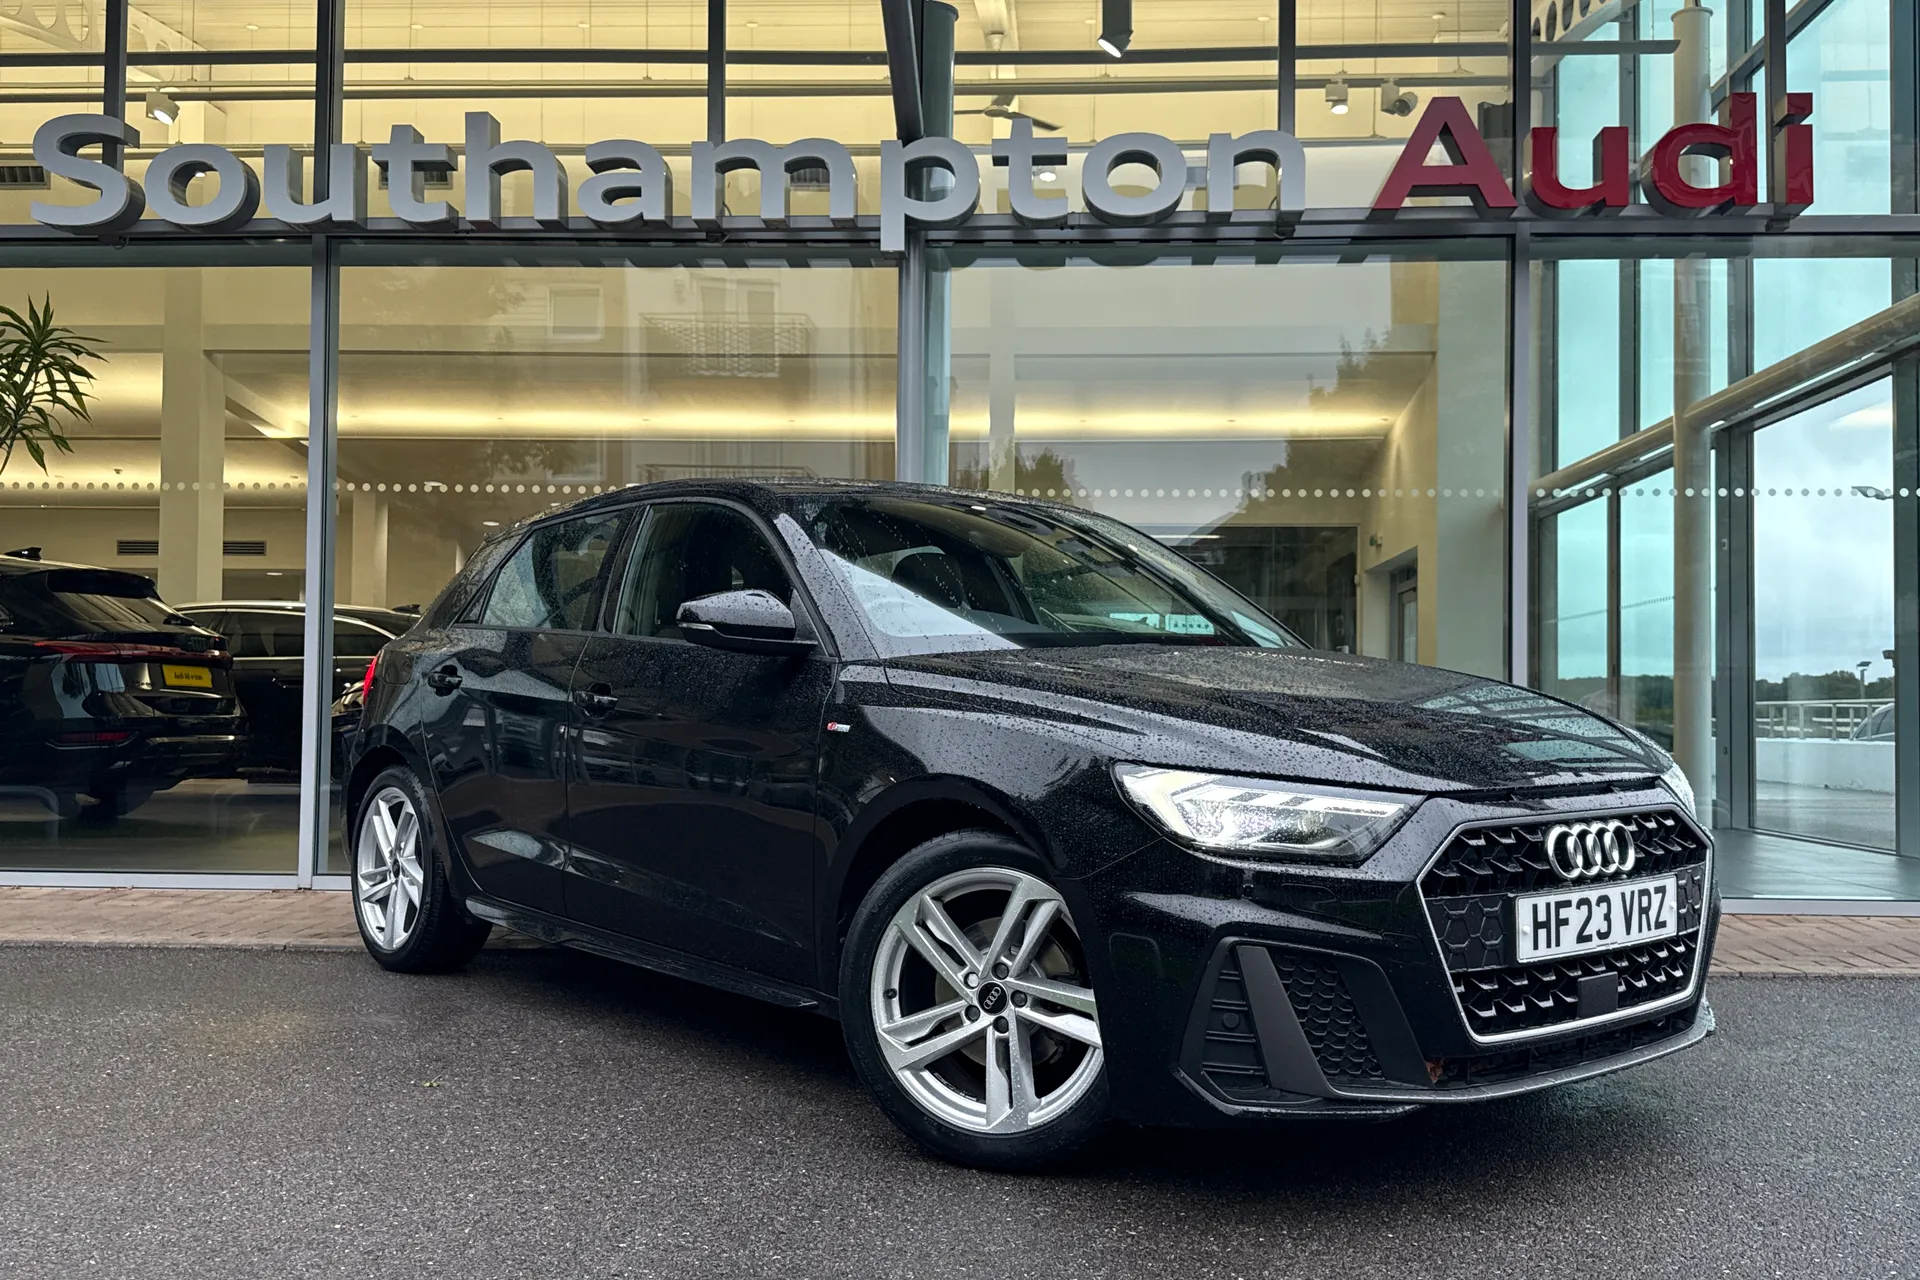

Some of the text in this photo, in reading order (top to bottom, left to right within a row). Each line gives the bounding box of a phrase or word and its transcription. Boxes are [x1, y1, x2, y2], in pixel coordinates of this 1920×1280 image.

[31, 92, 1814, 254] Southampton Audi
[1532, 885, 1667, 951] HF23 VRZ
